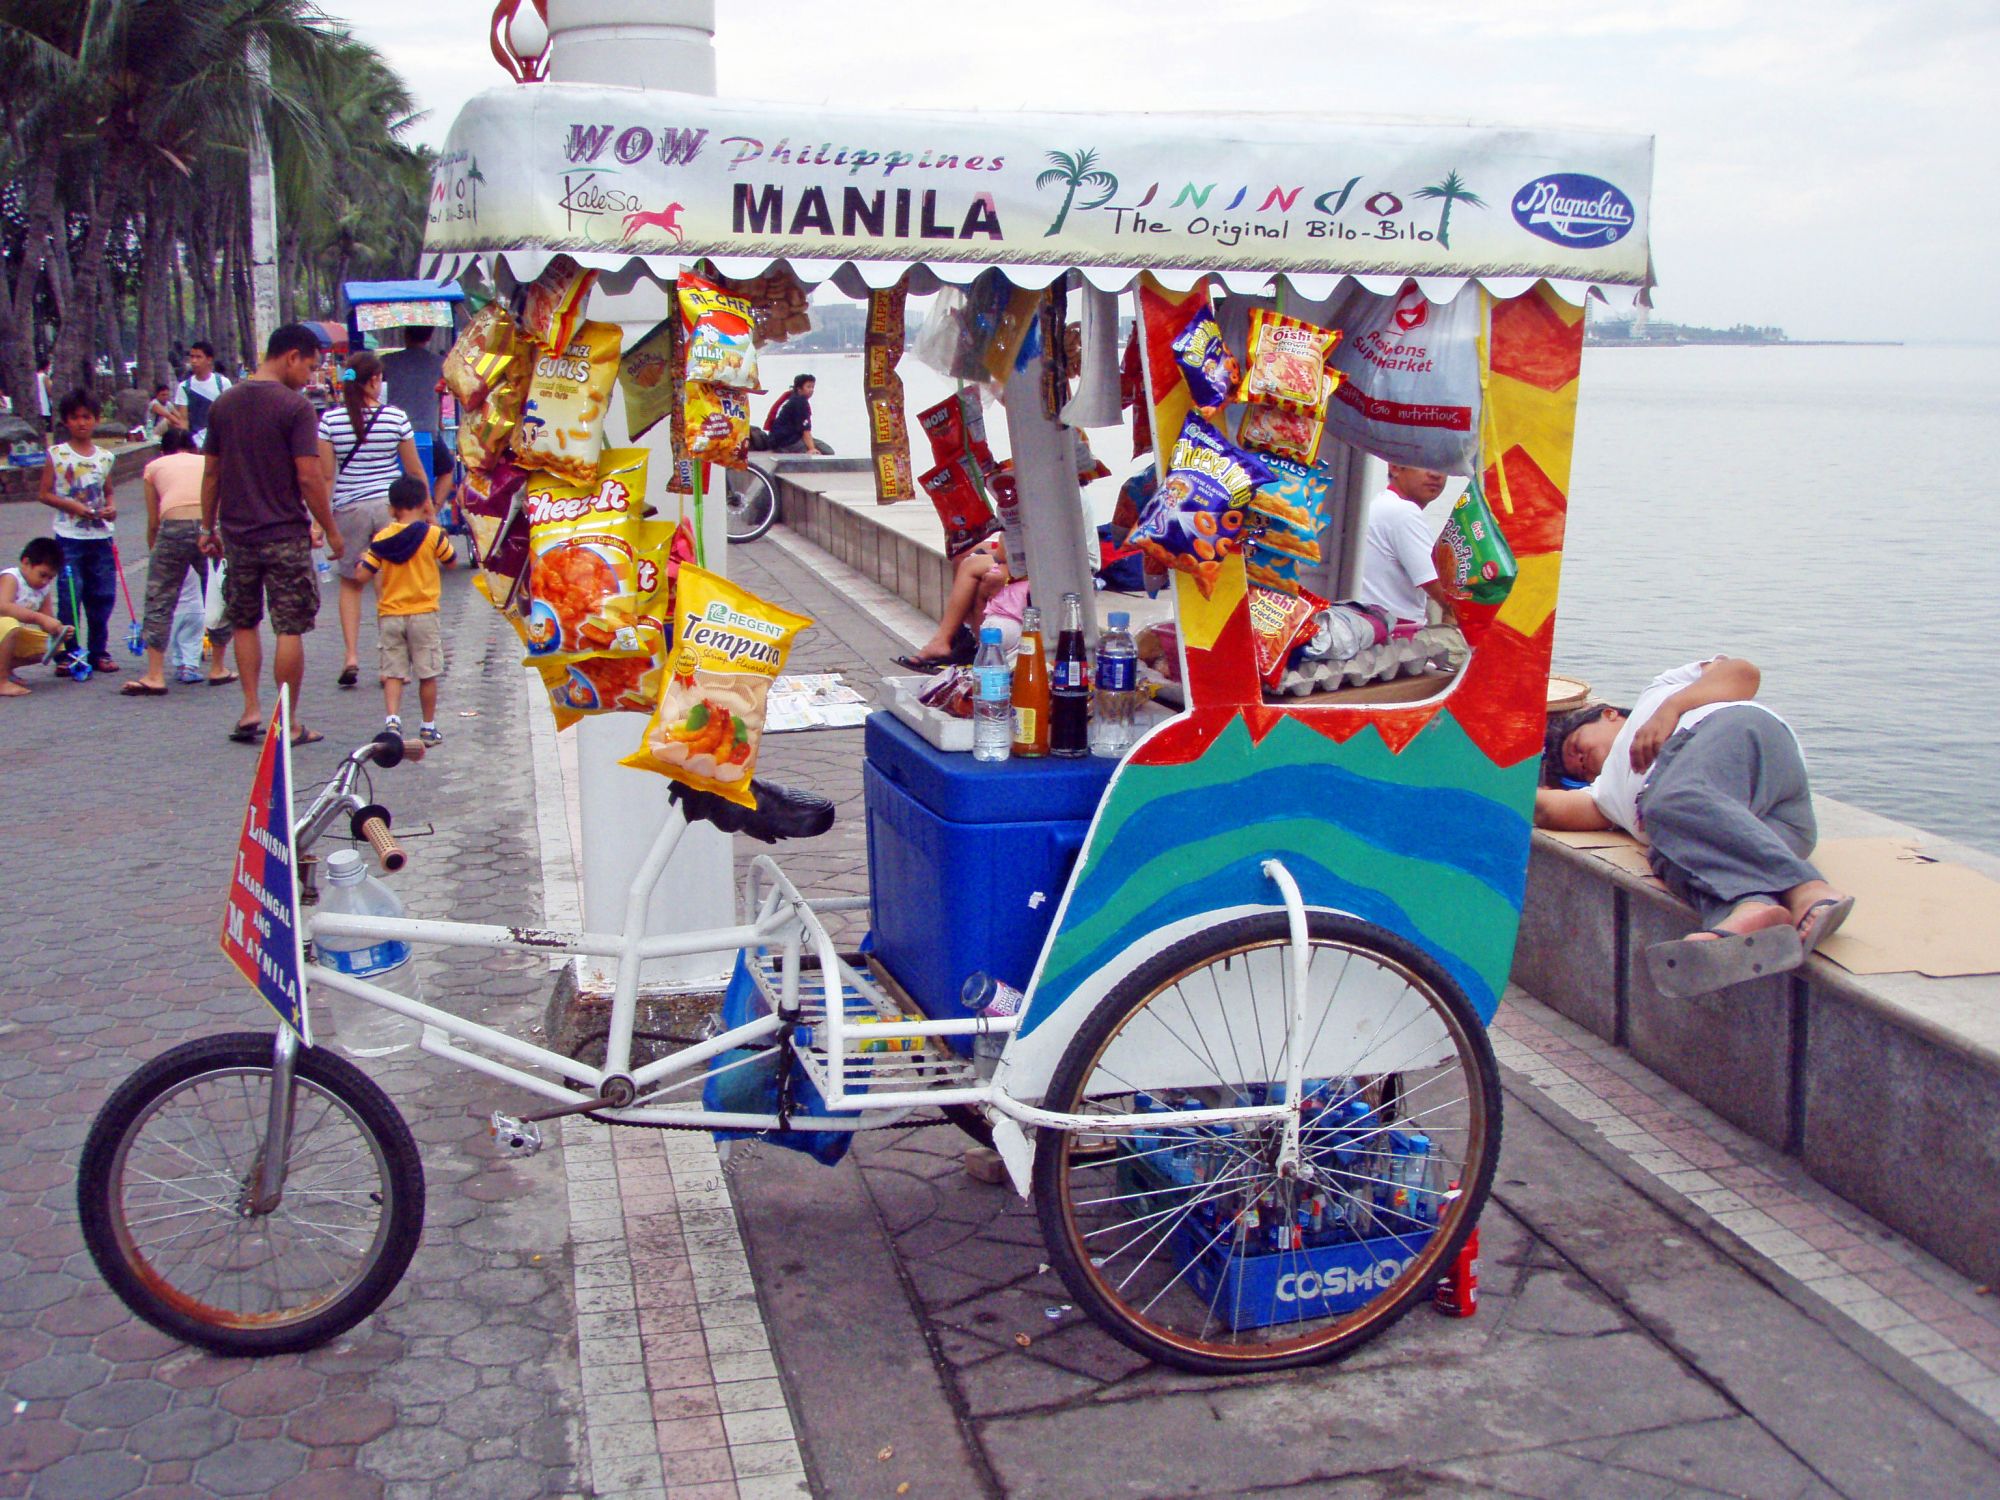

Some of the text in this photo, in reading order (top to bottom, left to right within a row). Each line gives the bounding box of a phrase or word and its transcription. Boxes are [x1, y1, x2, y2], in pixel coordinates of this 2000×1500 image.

[564, 124, 1006, 177] WOW Philippines
[732, 183, 1004, 241] MANILA
[1104, 206, 1434, 246] The Original Bilo-Bilo
[1517, 182, 1631, 238] Magnolia
[874, 291, 886, 332] HAPPY
[692, 345, 724, 360] MILK
[1273, 330, 1312, 342] Oishi
[536, 356, 592, 383] CURLS
[879, 401, 891, 441] HAPPY
[923, 407, 950, 430] MOBY
[1398, 407, 1461, 424] nutritious.
[883, 455, 897, 497] HAPPY
[1170, 438, 1232, 479] Cheese
[1259, 453, 1308, 478] CURLS
[925, 468, 952, 490] MOBY
[728, 612, 784, 638] REGENT
[1250, 604, 1283, 628] Crackers
[1258, 600, 1284, 619] Prawn
[682, 613, 781, 667] Tempura
[248, 804, 290, 866] LINISIN
[237, 849, 292, 929] IKARANGAL
[252, 909, 271, 940] ANG
